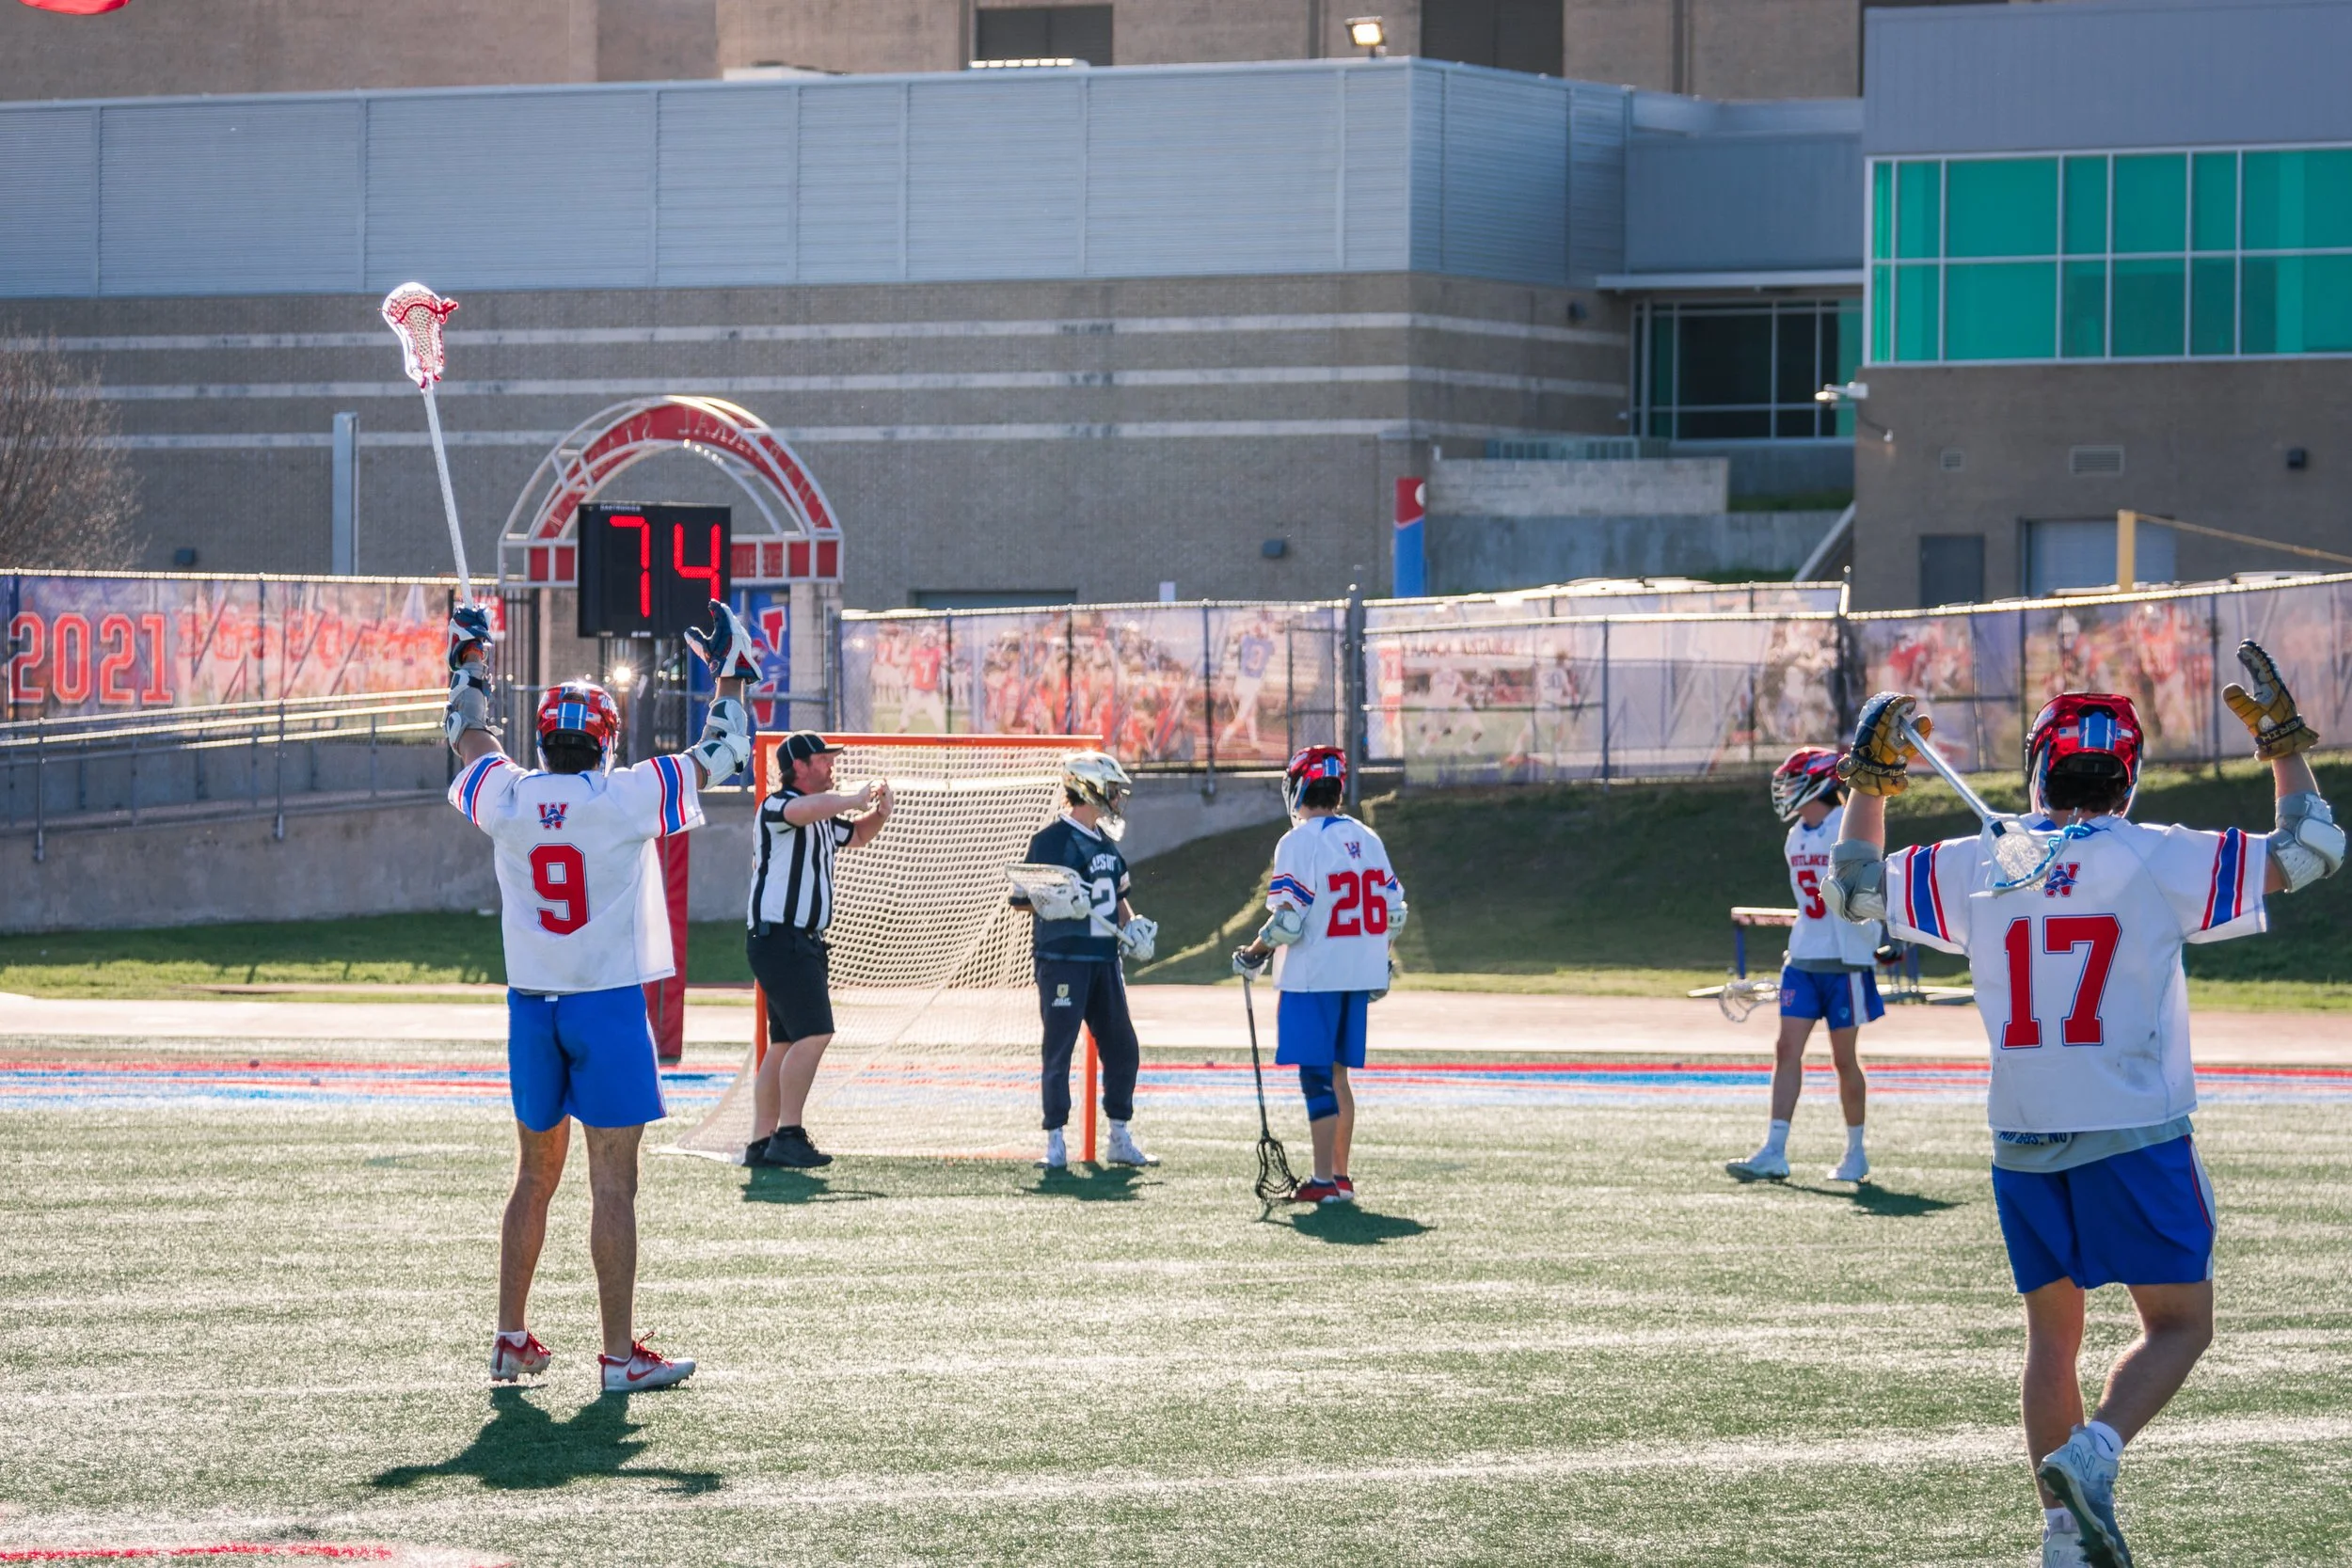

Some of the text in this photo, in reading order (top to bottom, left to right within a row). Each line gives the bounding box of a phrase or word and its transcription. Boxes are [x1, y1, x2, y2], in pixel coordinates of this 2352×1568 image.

[610, 515, 721, 618] 74
[8, 611, 174, 705] 2021
[537, 802, 568, 830] W
[528, 843, 591, 936] 9
[1326, 867, 1389, 938] 26
[1797, 869, 1827, 920] 5
[2001, 913, 2122, 1051] 17
